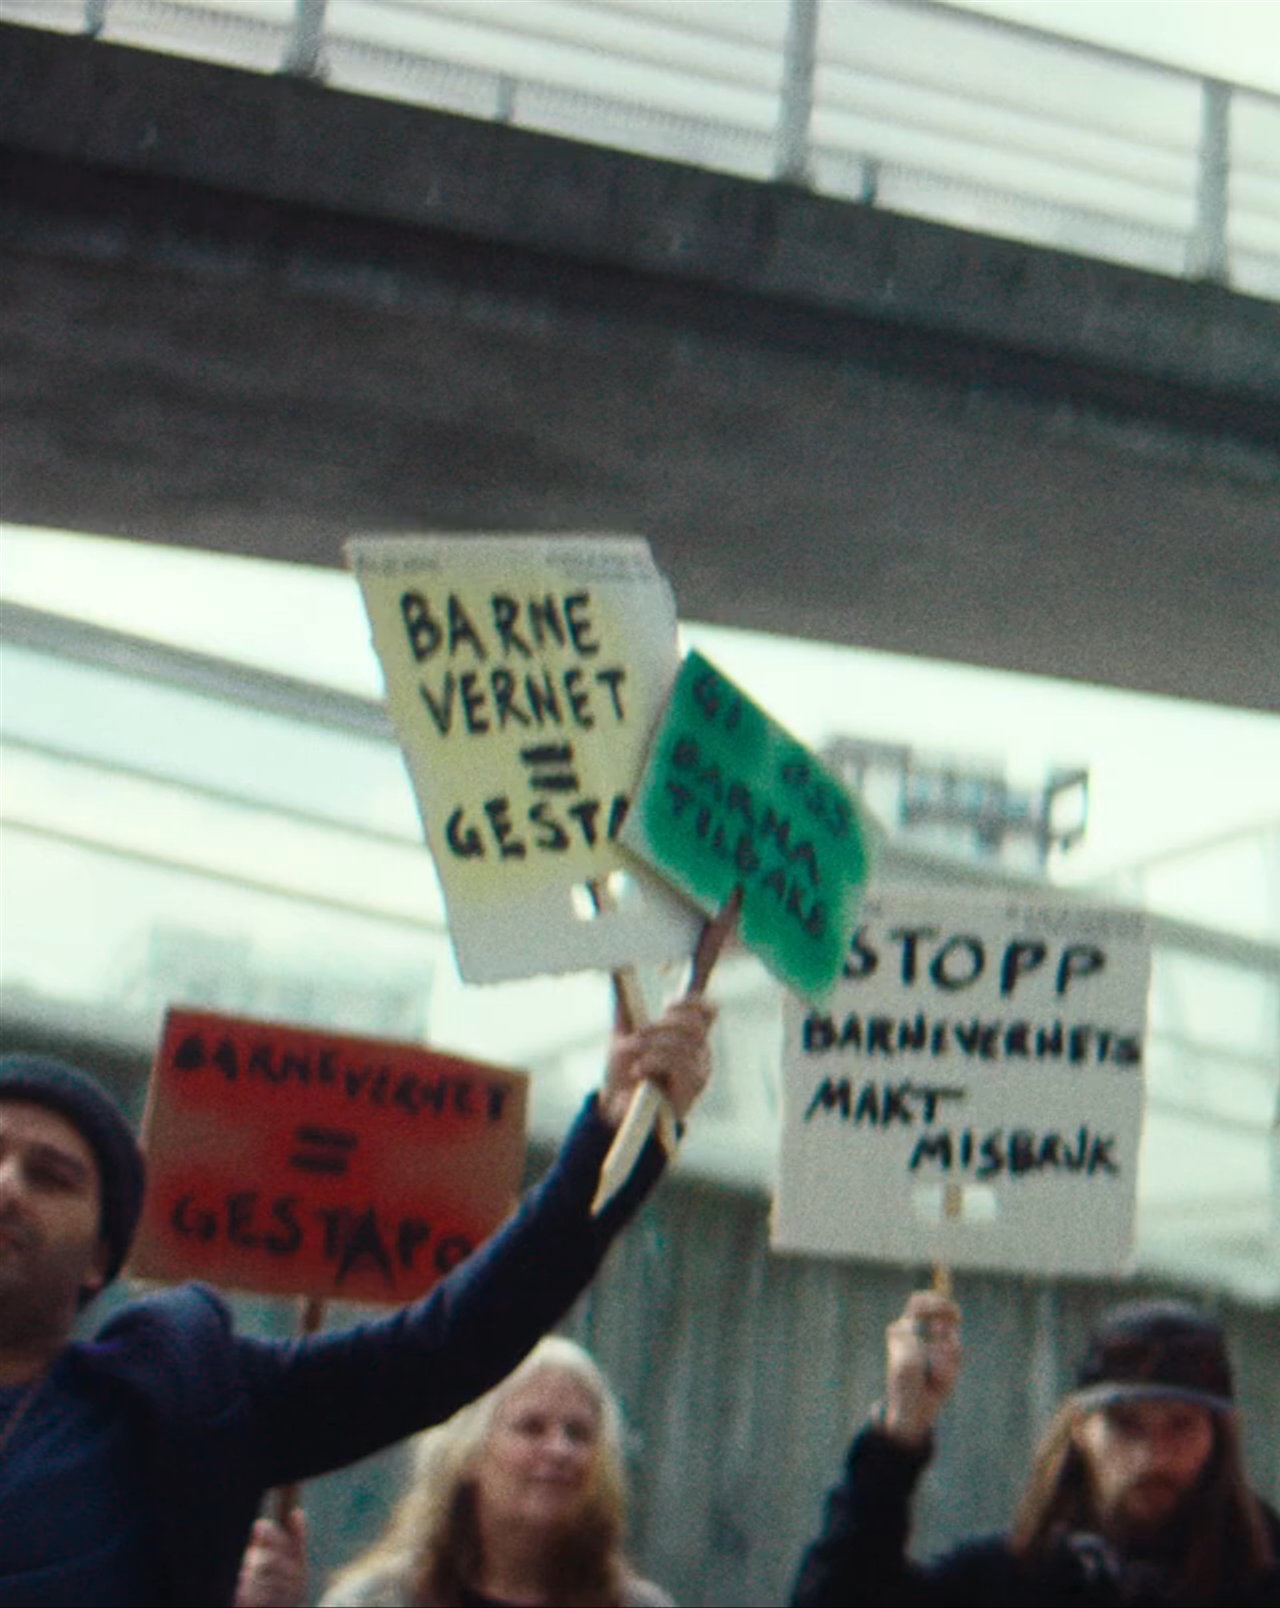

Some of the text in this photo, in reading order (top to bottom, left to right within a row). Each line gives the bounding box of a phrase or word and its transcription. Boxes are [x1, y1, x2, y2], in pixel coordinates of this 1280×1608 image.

[400, 590, 600, 662] BARNE
[419, 667, 628, 736] VERNET
[444, 795, 630, 861] GEST
[842, 925, 1106, 998] STOPP
[804, 1076, 966, 1128] MAKT
[907, 1124, 1120, 1180] MISBRUK
[171, 1191, 476, 1288] GESTAPO
